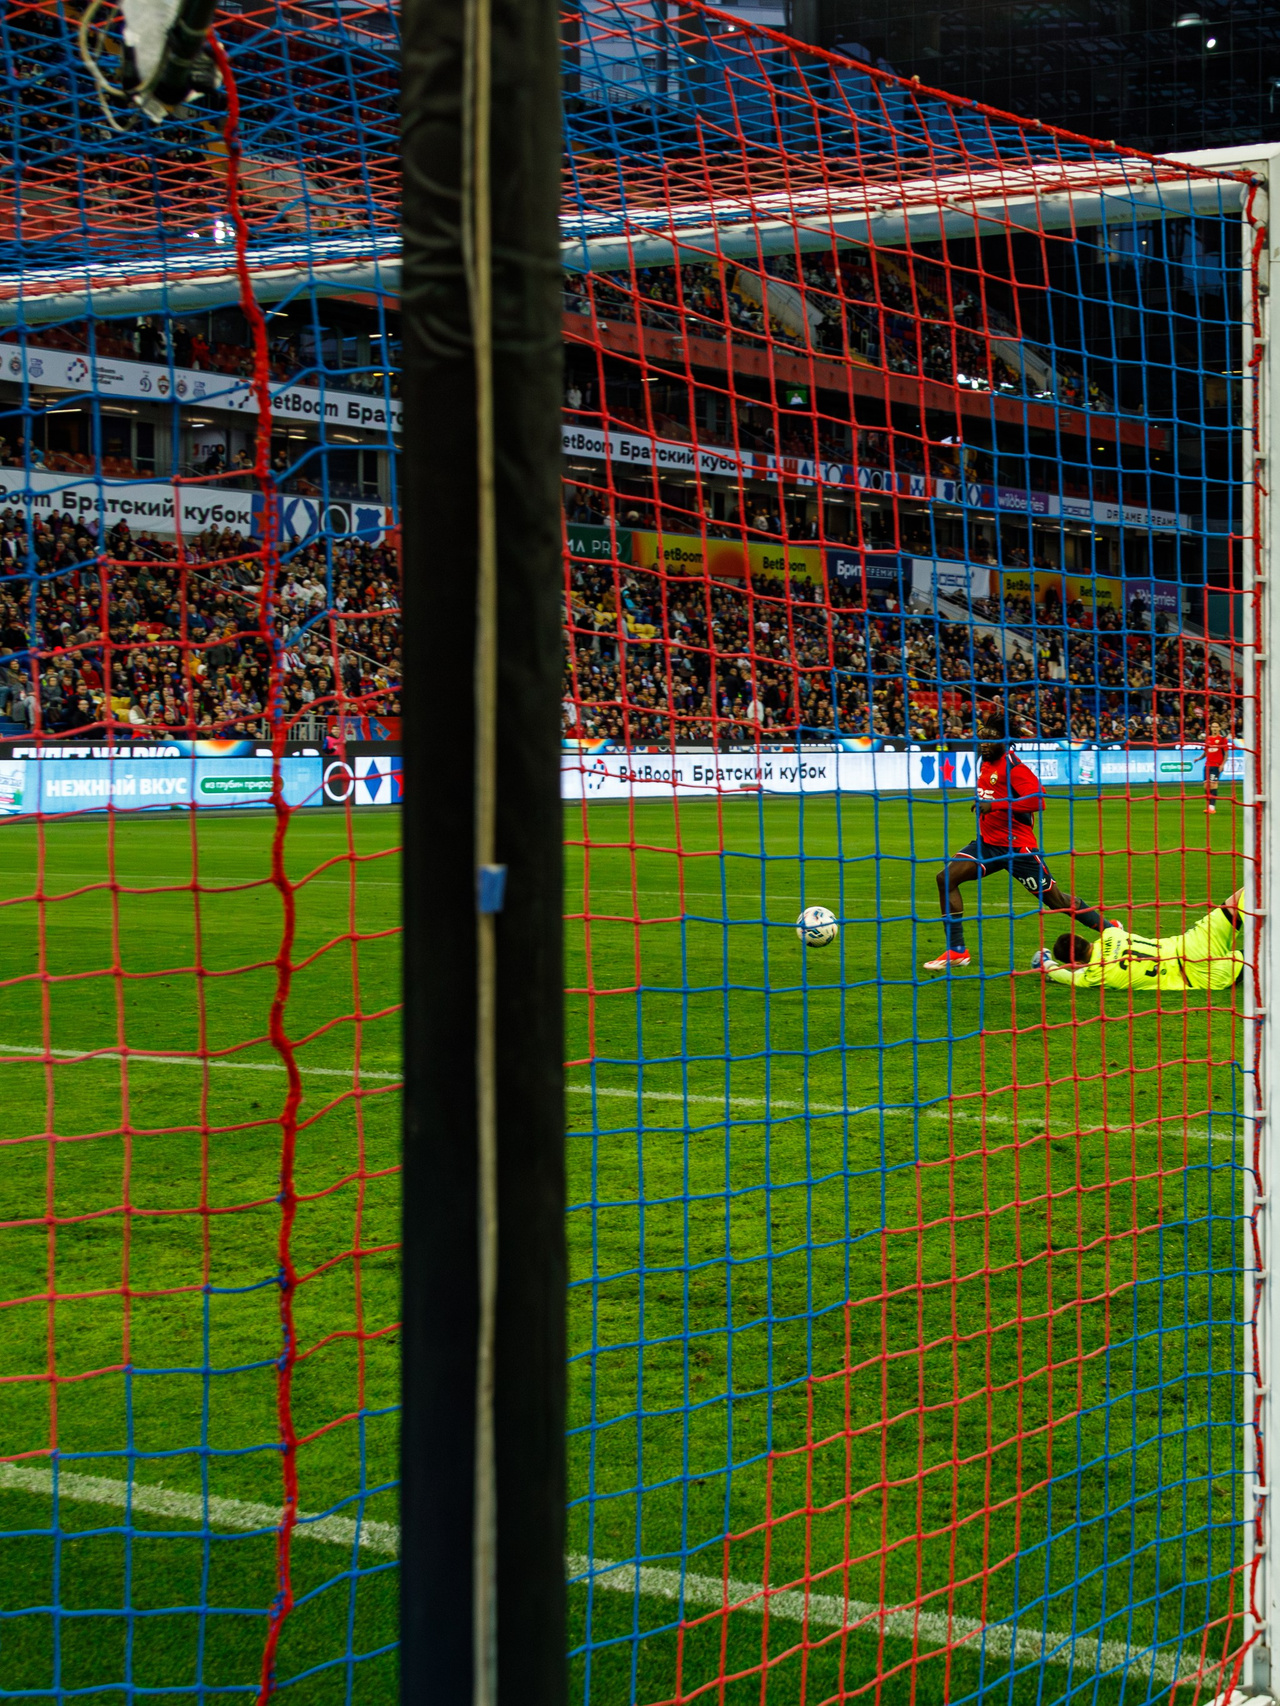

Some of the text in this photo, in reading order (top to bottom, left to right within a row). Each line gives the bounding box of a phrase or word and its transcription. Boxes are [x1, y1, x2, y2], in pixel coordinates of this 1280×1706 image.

[269, 393, 339, 417] etBoom
[562, 434, 614, 454] etBoom
[184, 504, 250, 525] кубок
[619, 762, 827, 785] BetBoom Братский кубок
[46, 774, 136, 797] НЕЖНЫЙ
[140, 777, 188, 795] ВКУС
